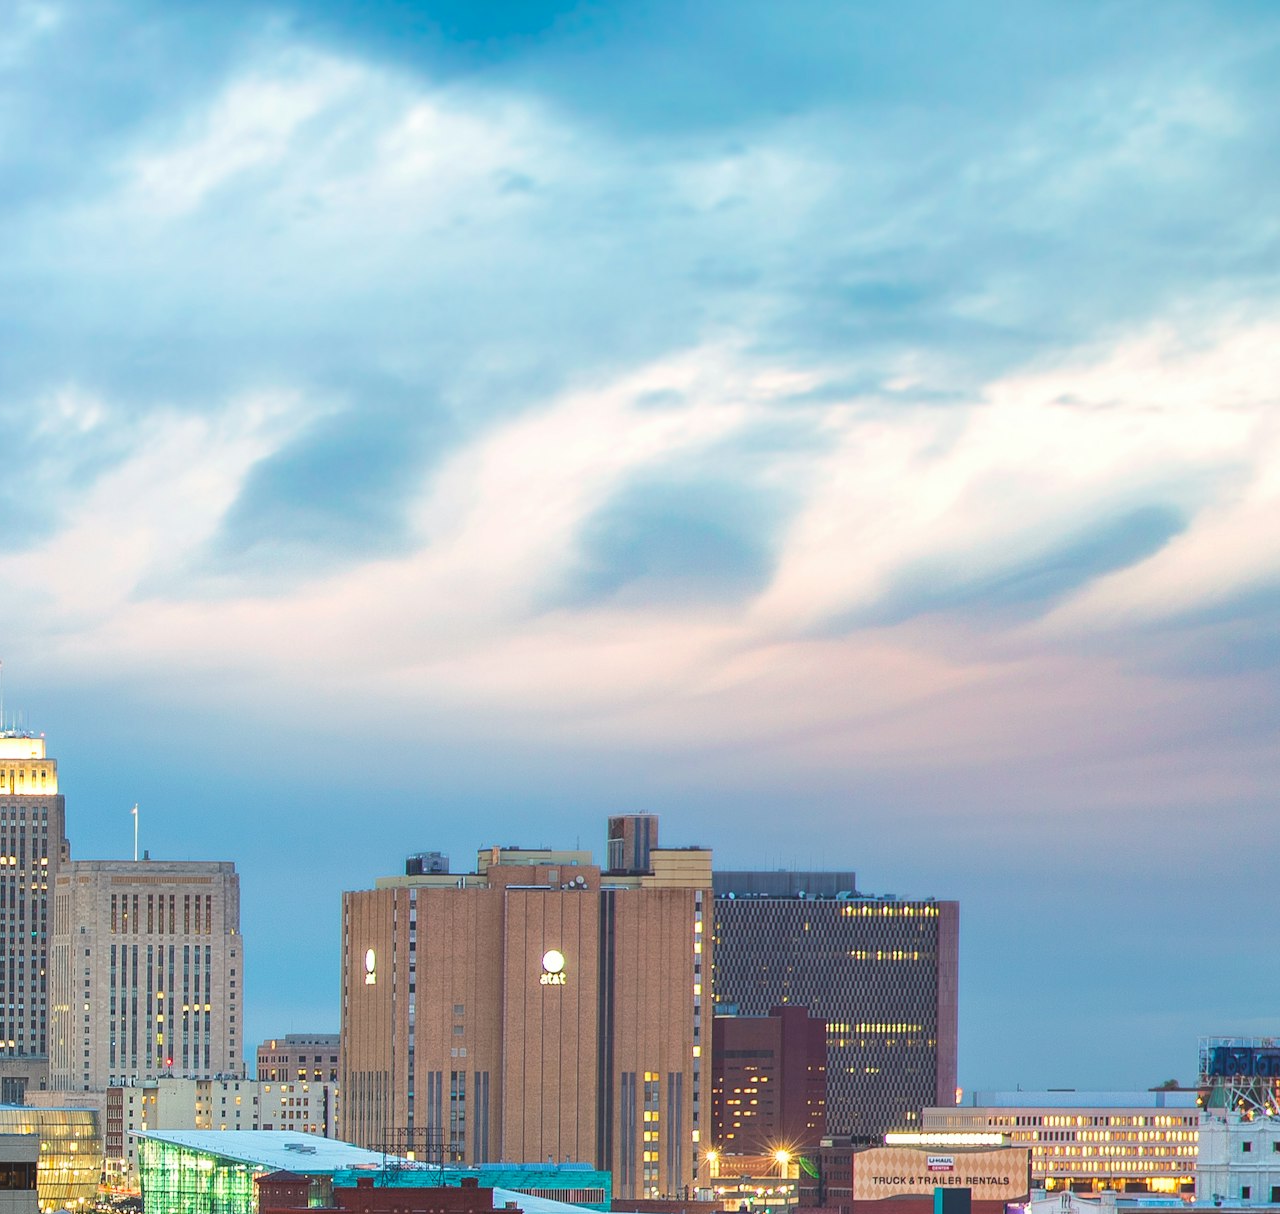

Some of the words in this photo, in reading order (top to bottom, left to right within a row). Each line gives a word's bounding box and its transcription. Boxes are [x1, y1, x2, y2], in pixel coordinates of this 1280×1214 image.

[872, 1176, 907, 1185] TRUCK
[908, 1176, 915, 1185] &
[919, 1176, 962, 1185] TRAILER
[965, 1176, 1010, 1186] RENTALS
